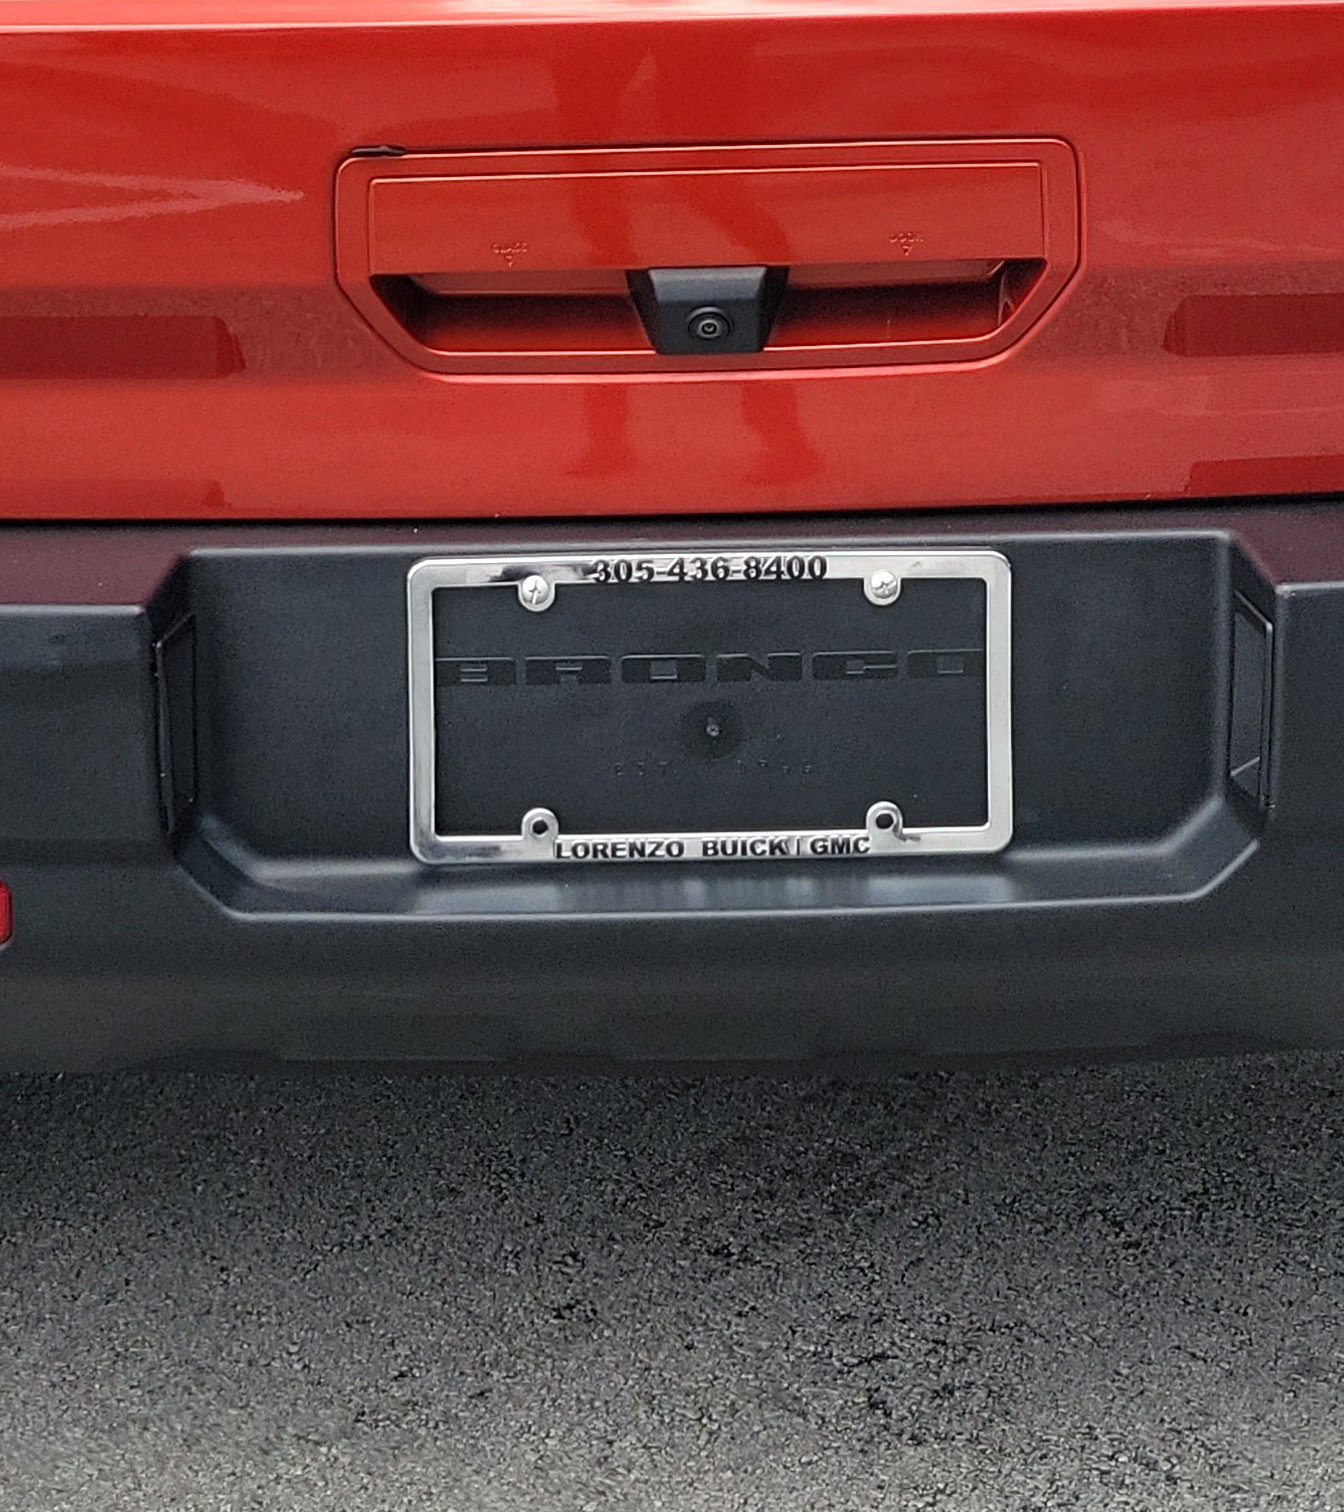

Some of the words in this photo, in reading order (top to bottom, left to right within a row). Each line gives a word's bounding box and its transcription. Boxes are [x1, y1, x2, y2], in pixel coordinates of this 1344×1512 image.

[590, 555, 828, 584] 305-436-8400
[433, 647, 986, 687] BRONCO
[556, 837, 685, 860] LORENZO
[702, 835, 789, 858] BUICK
[809, 834, 872, 857] GMC
